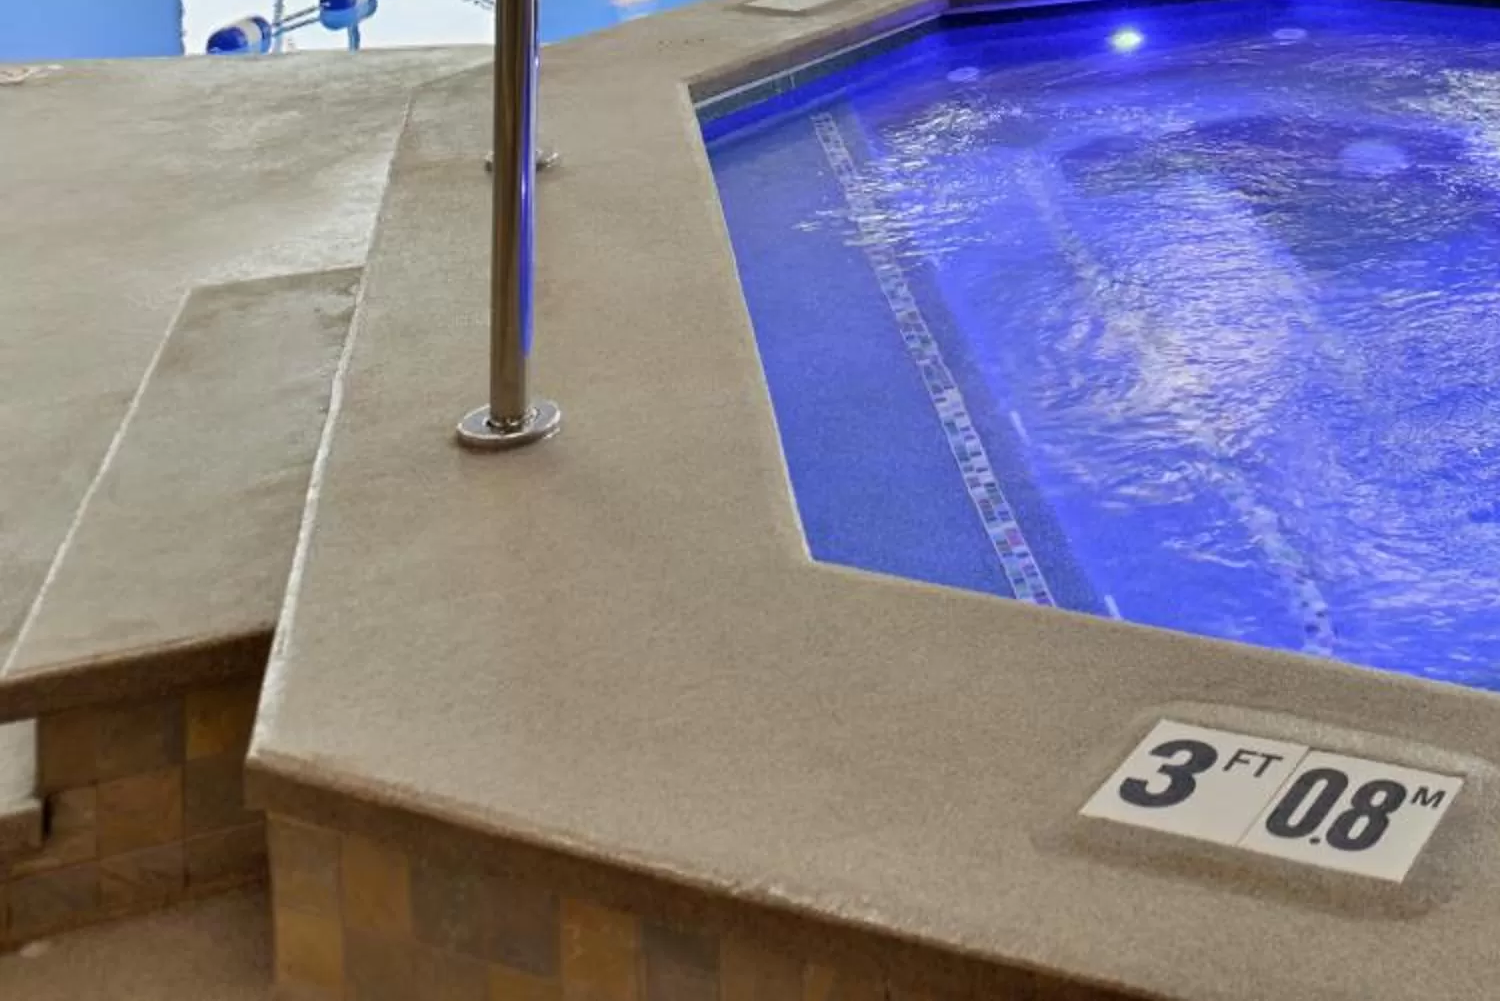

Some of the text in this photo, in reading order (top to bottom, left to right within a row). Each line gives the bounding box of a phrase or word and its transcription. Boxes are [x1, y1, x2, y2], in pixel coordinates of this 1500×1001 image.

[1118, 739, 1219, 809] 3
[1222, 748, 1284, 778] FT
[1410, 786, 1447, 810] M
